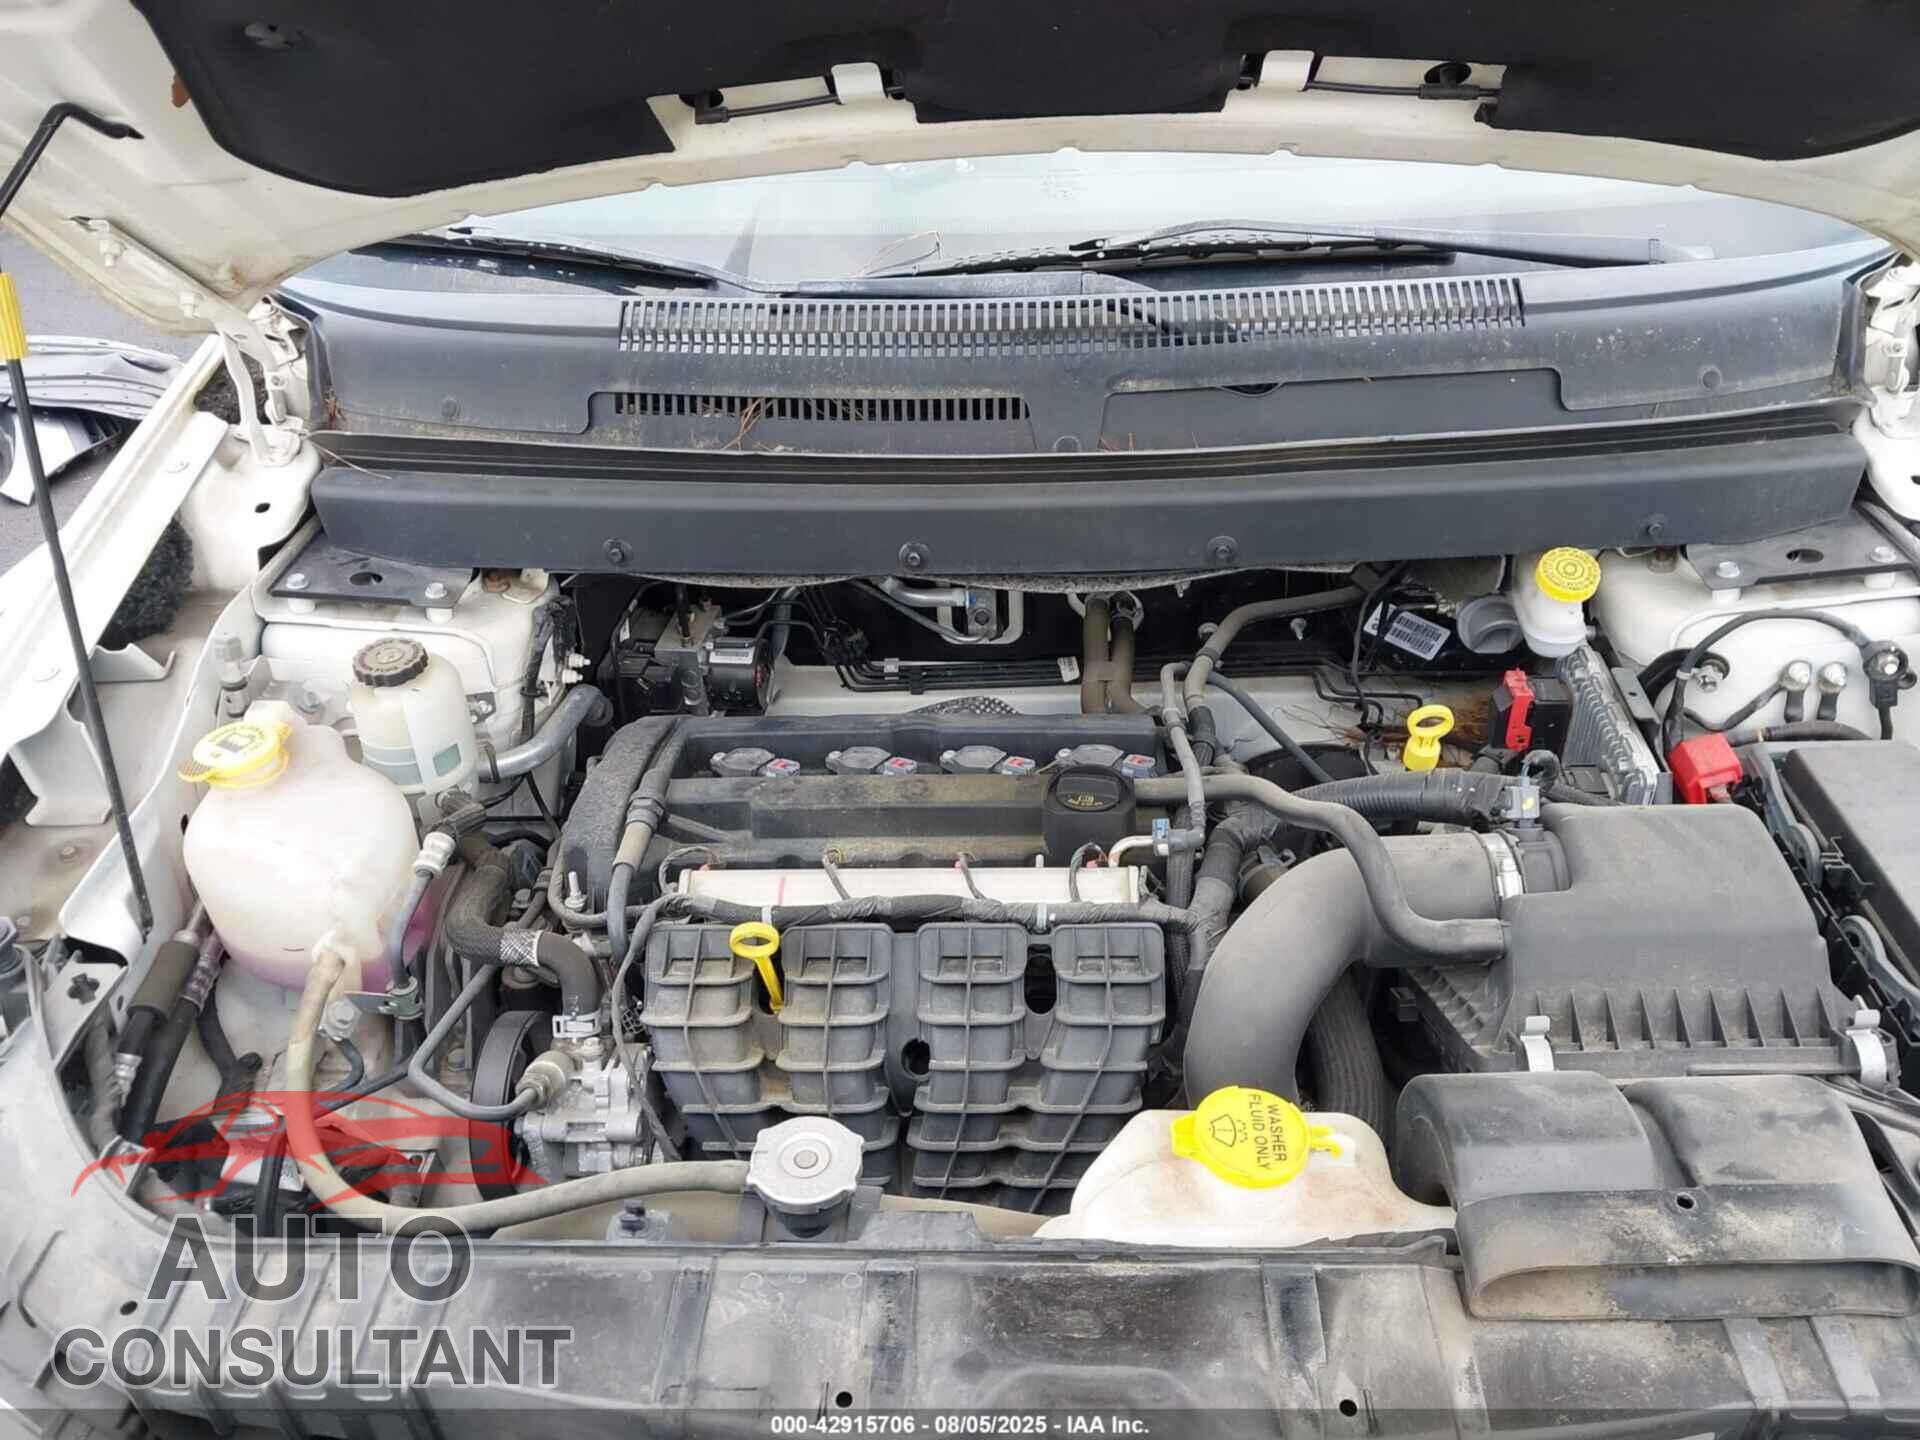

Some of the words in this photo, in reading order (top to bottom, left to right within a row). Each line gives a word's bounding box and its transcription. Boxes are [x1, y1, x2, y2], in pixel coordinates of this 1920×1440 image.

[1247, 1093, 1266, 1132] FLUID
[1266, 1103, 1287, 1162] WASHER
[1253, 1135, 1272, 1171] ONLY
